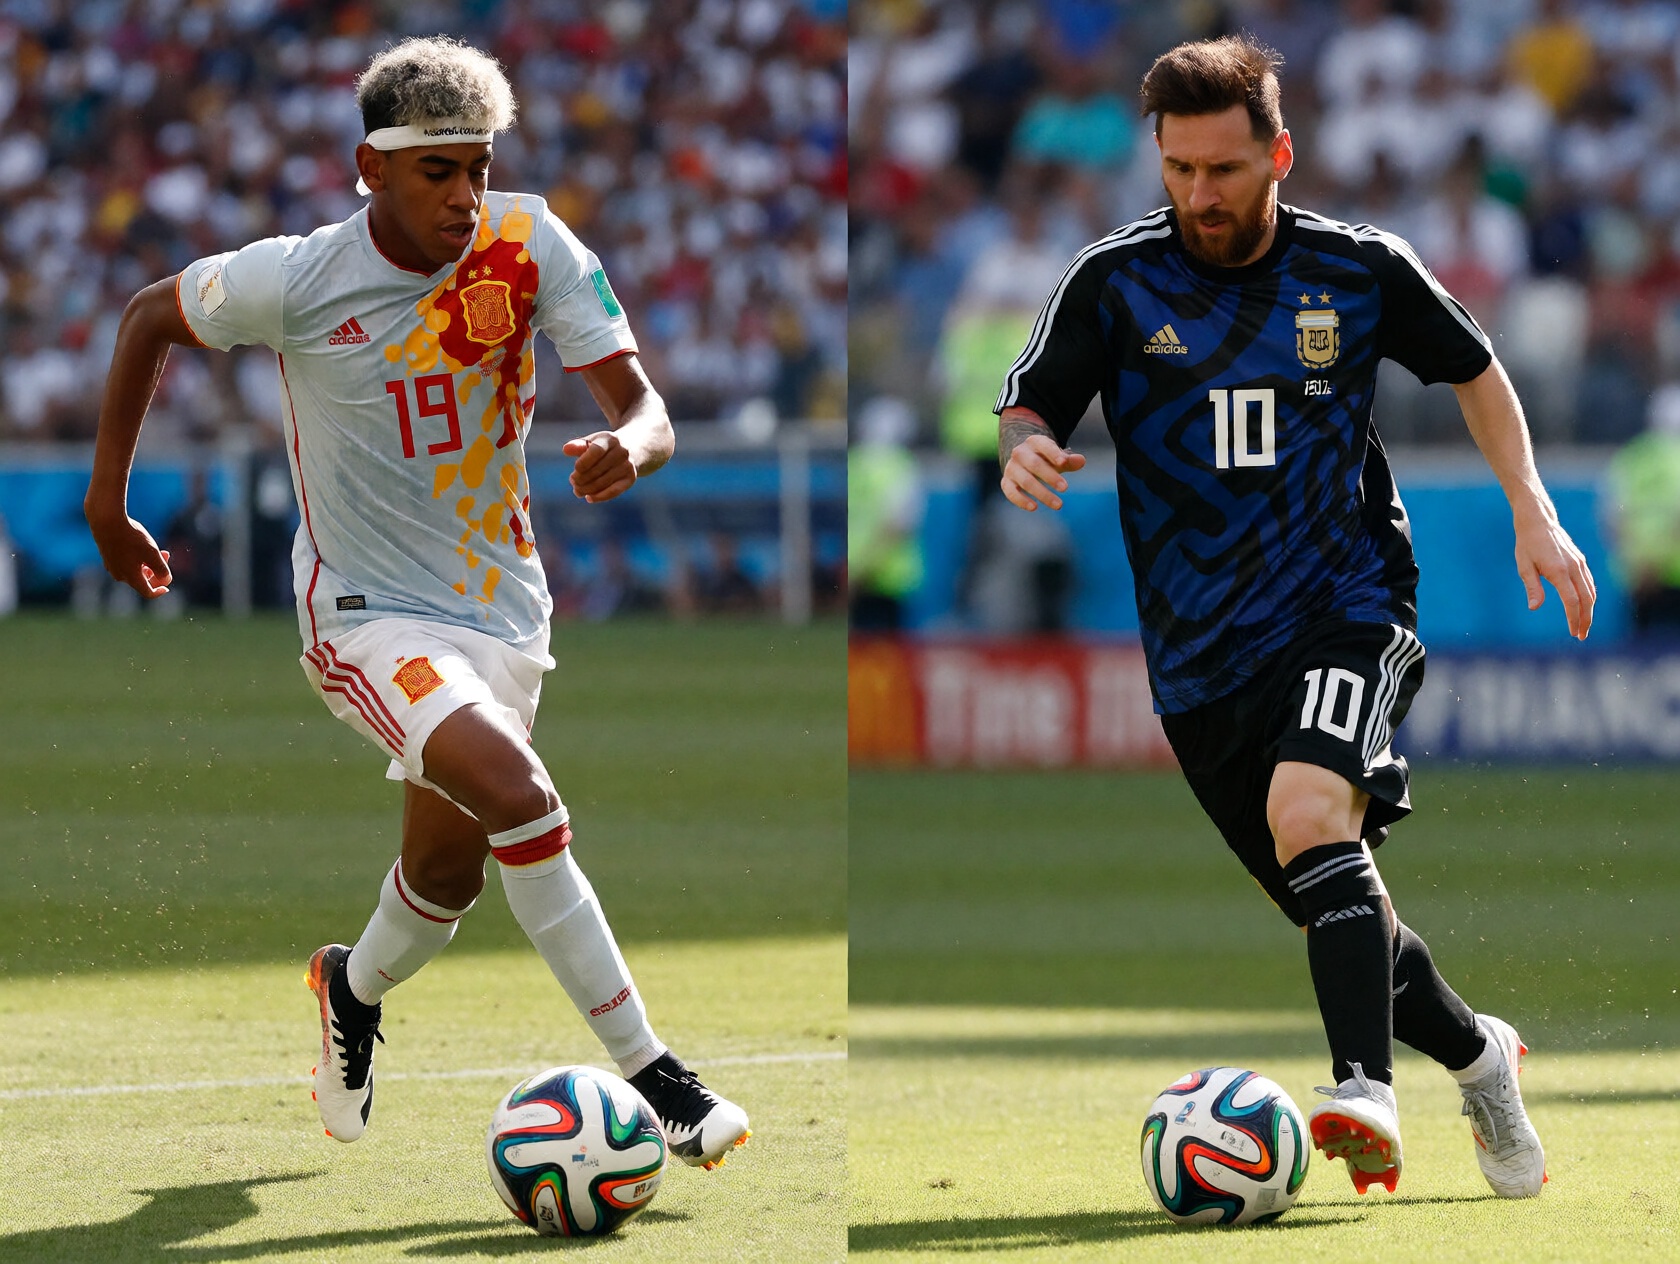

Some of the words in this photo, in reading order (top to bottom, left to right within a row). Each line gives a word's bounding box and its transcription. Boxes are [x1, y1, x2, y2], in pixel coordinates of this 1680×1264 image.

[1143, 343, 1188, 354] adidas
[385, 373, 463, 458] 19
[1209, 388, 1276, 469] 10
[1300, 667, 1366, 742] 10
